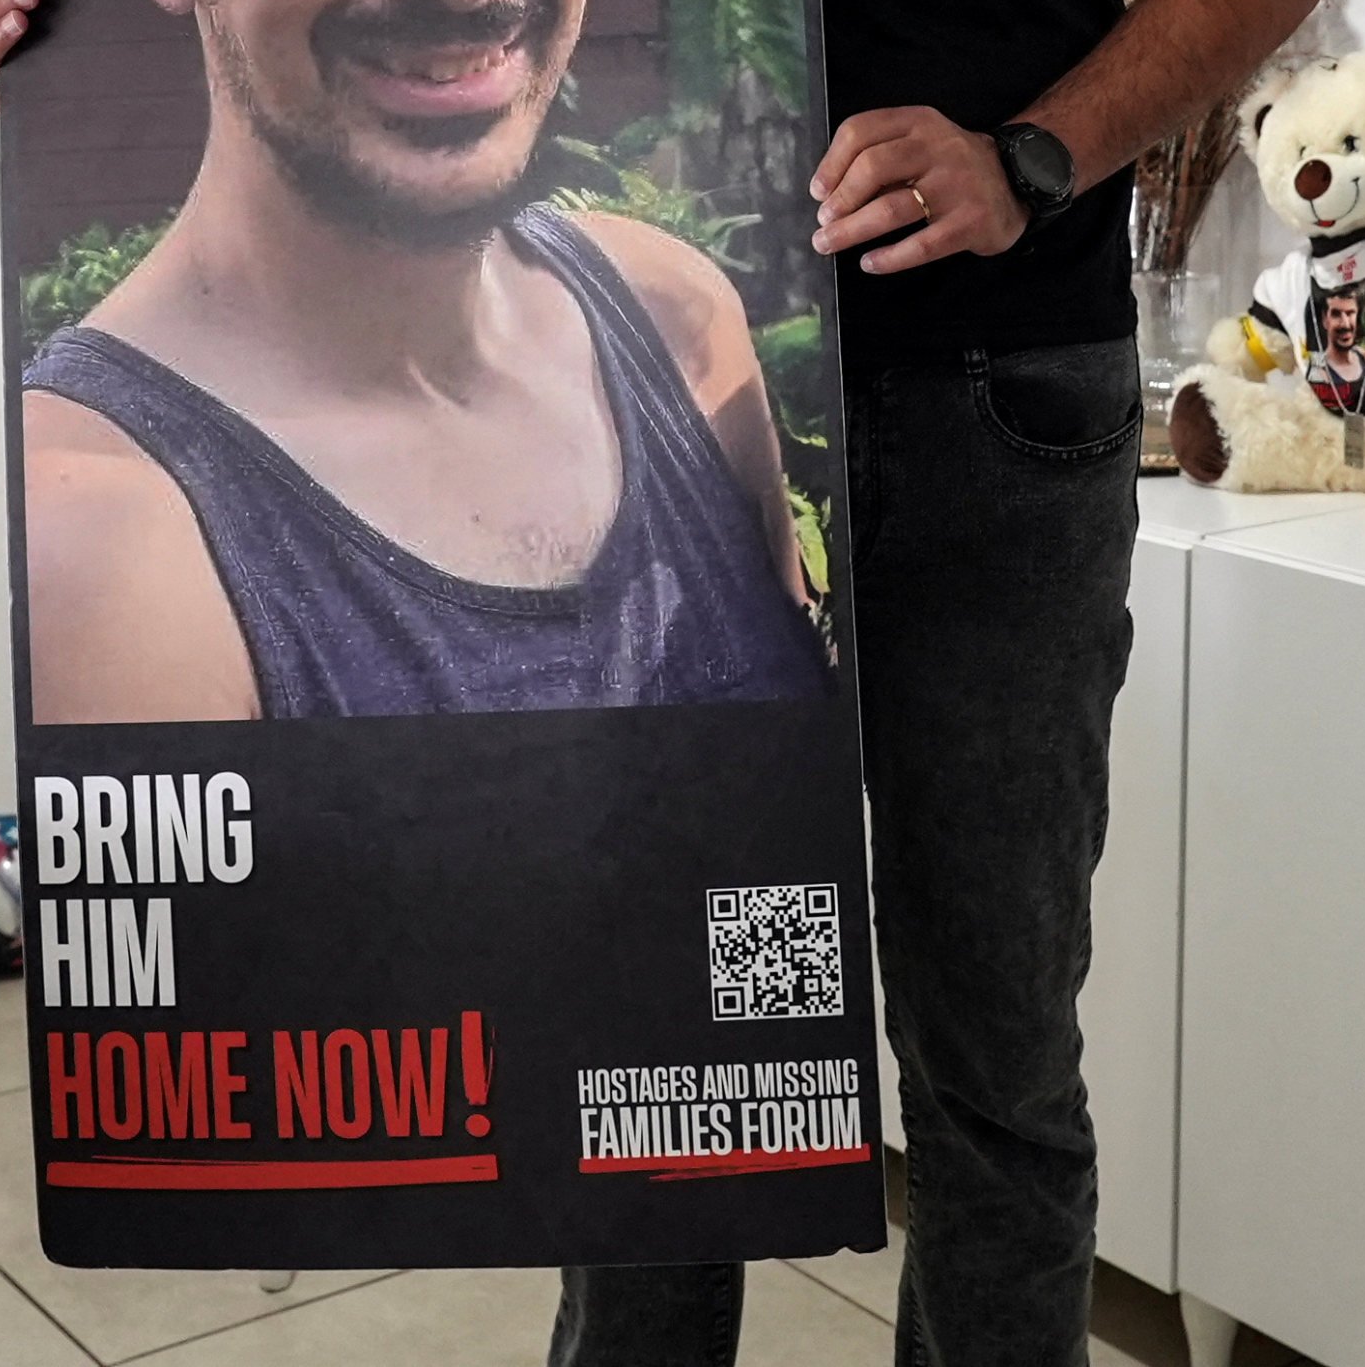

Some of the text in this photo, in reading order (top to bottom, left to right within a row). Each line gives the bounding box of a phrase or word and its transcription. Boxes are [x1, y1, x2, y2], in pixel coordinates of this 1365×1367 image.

[34, 771, 255, 885] BRING
[39, 897, 176, 1007] HIM
[47, 1010, 494, 1141] HOME NOW!
[577, 1058, 859, 1105] HOSTAGES AND MISSING
[580, 1097, 862, 1160] FAMILIES FORUM
